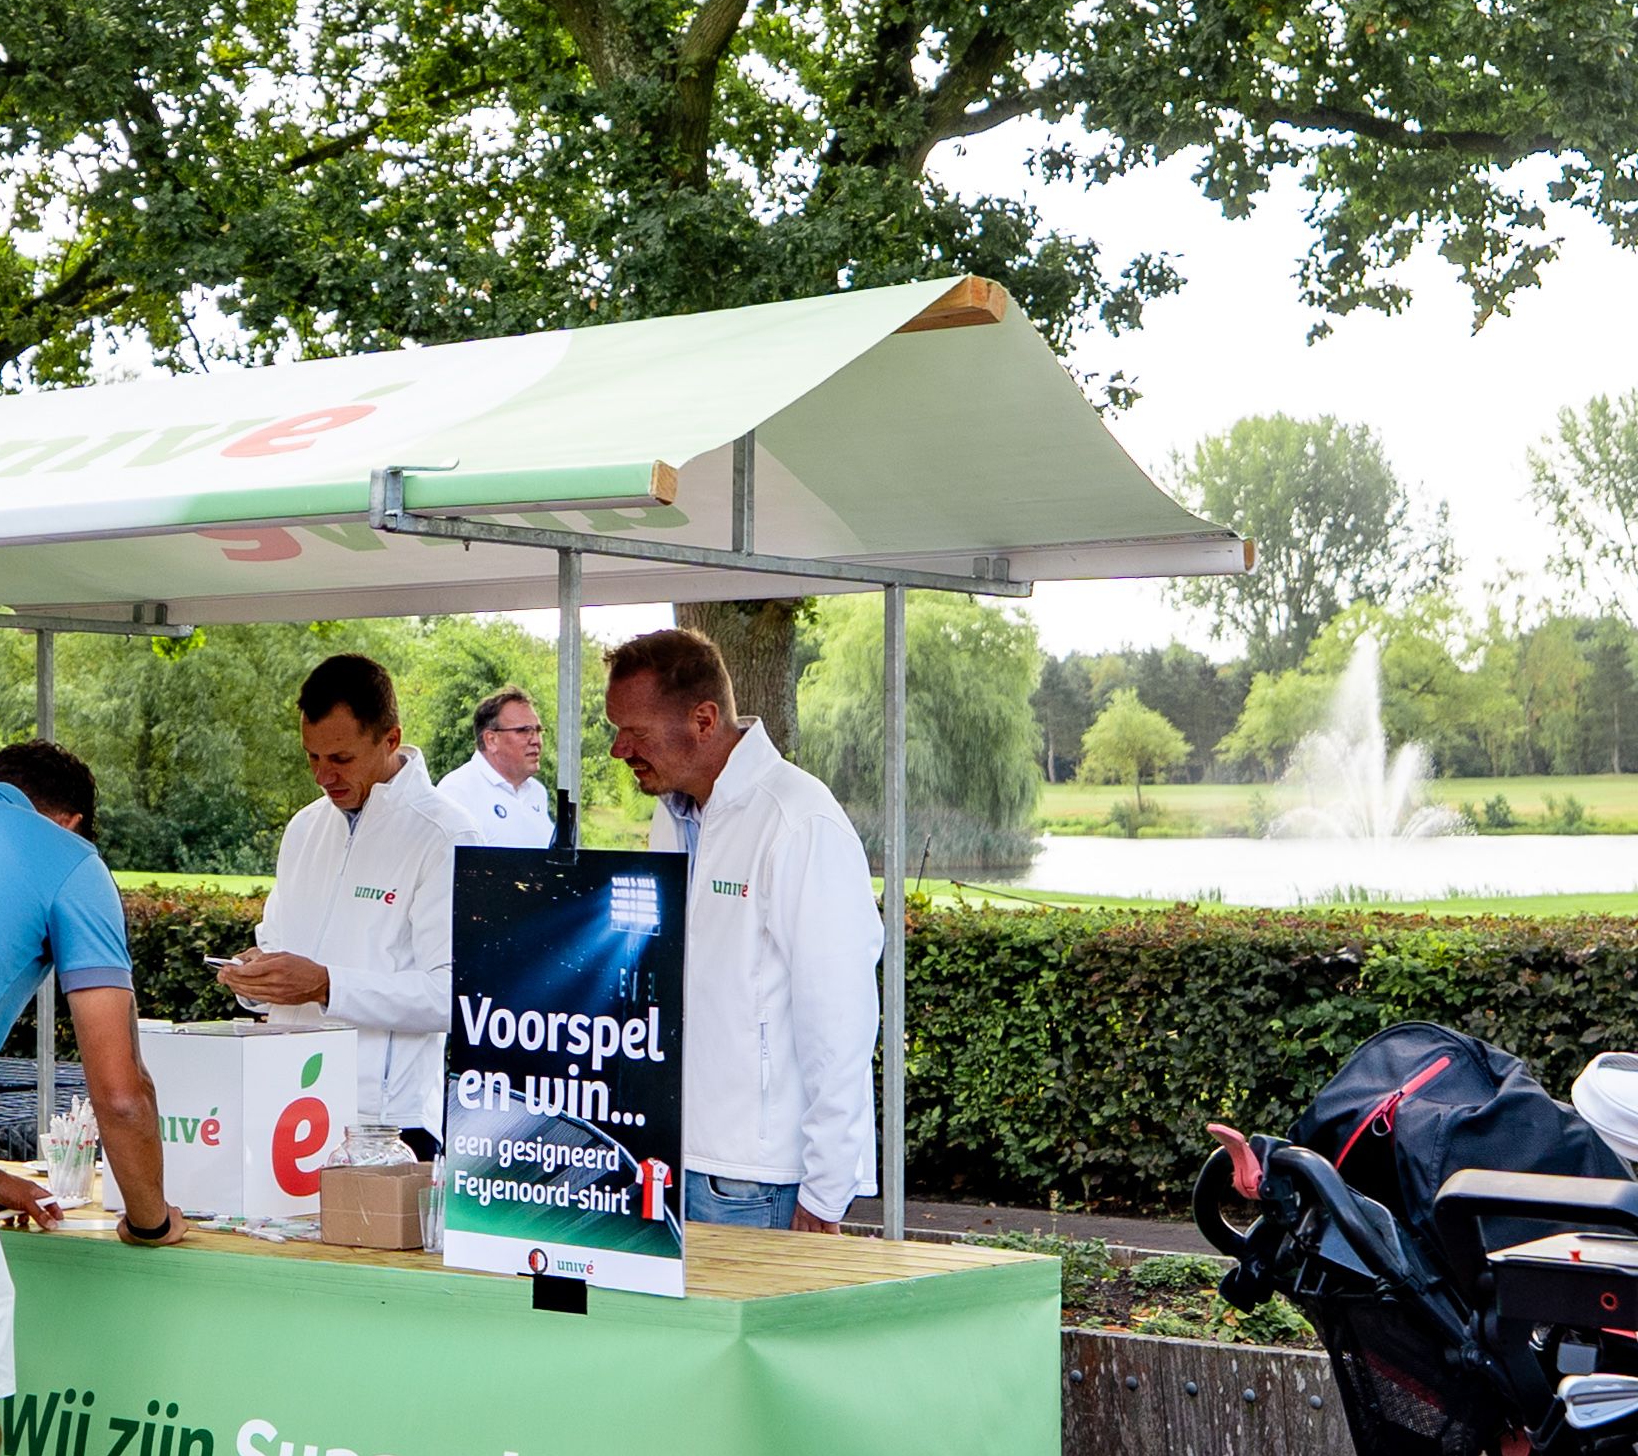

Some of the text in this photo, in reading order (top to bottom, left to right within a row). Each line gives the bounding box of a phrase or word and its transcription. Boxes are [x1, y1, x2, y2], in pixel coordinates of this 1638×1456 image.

[458, 994, 666, 1071] Voorspel
[456, 1063, 646, 1127] en win...
[453, 1133, 620, 1173] een gesigneerd
[453, 1169, 631, 1216] Feyenoord-shirt
